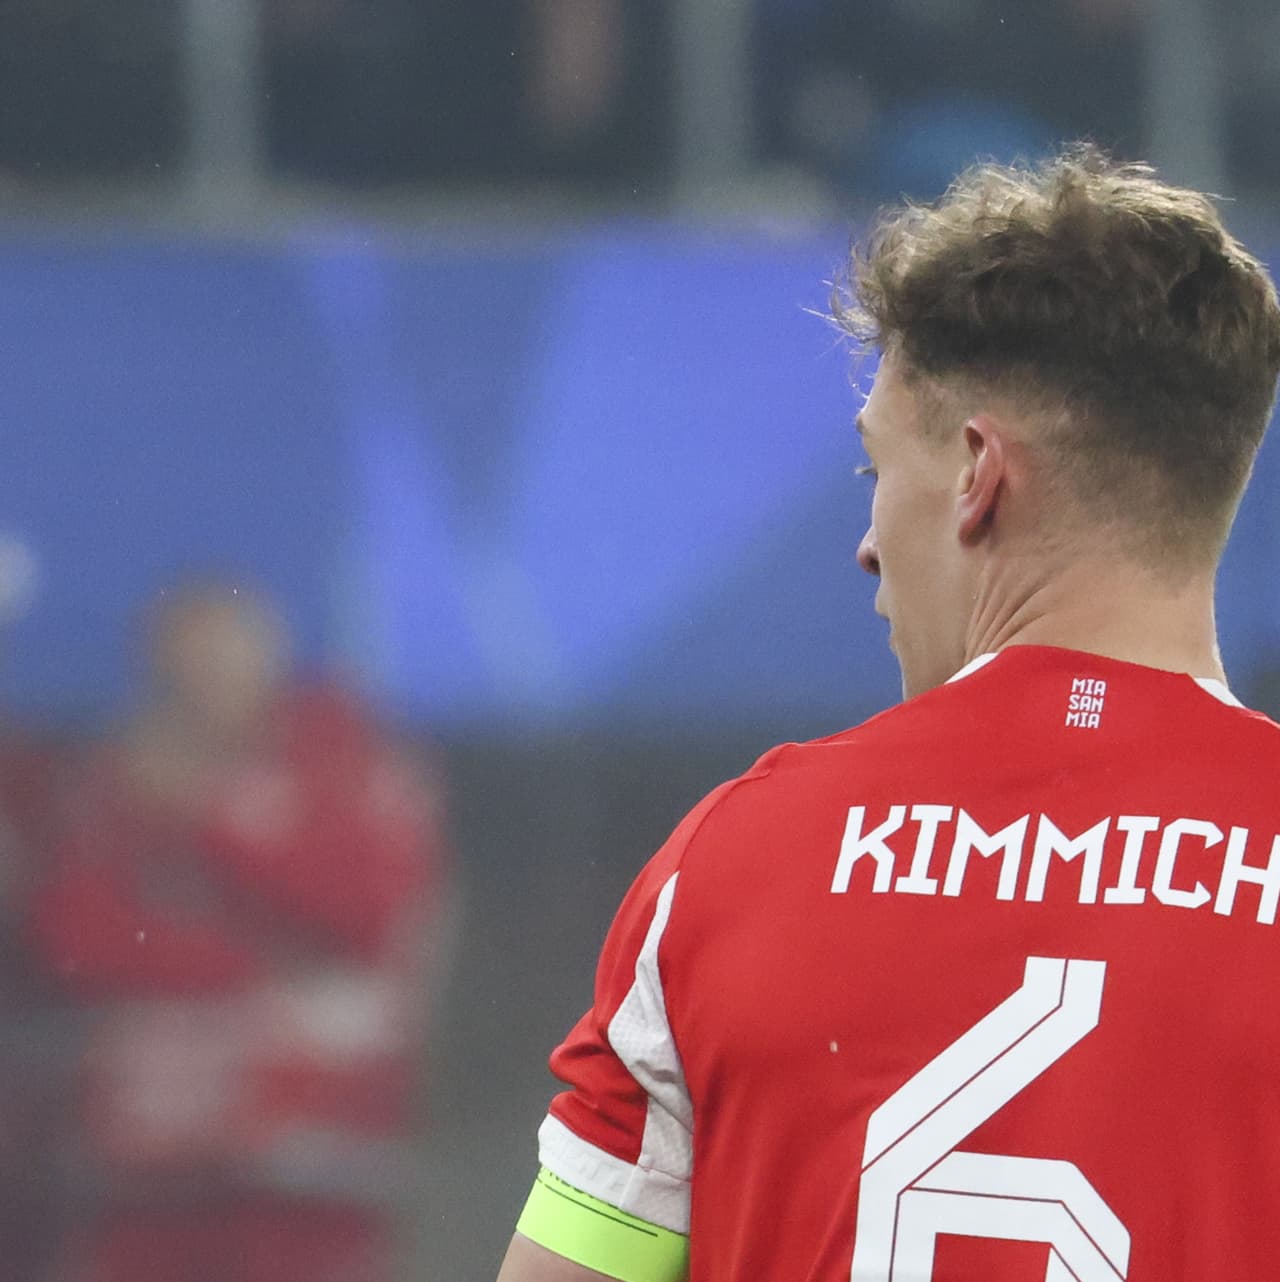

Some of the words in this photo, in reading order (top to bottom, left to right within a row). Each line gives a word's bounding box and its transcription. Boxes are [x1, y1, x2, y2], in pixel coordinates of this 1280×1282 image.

[1071, 678, 1106, 697] MIA
[1068, 694, 1104, 712] SAN
[1065, 711, 1101, 729] MIA
